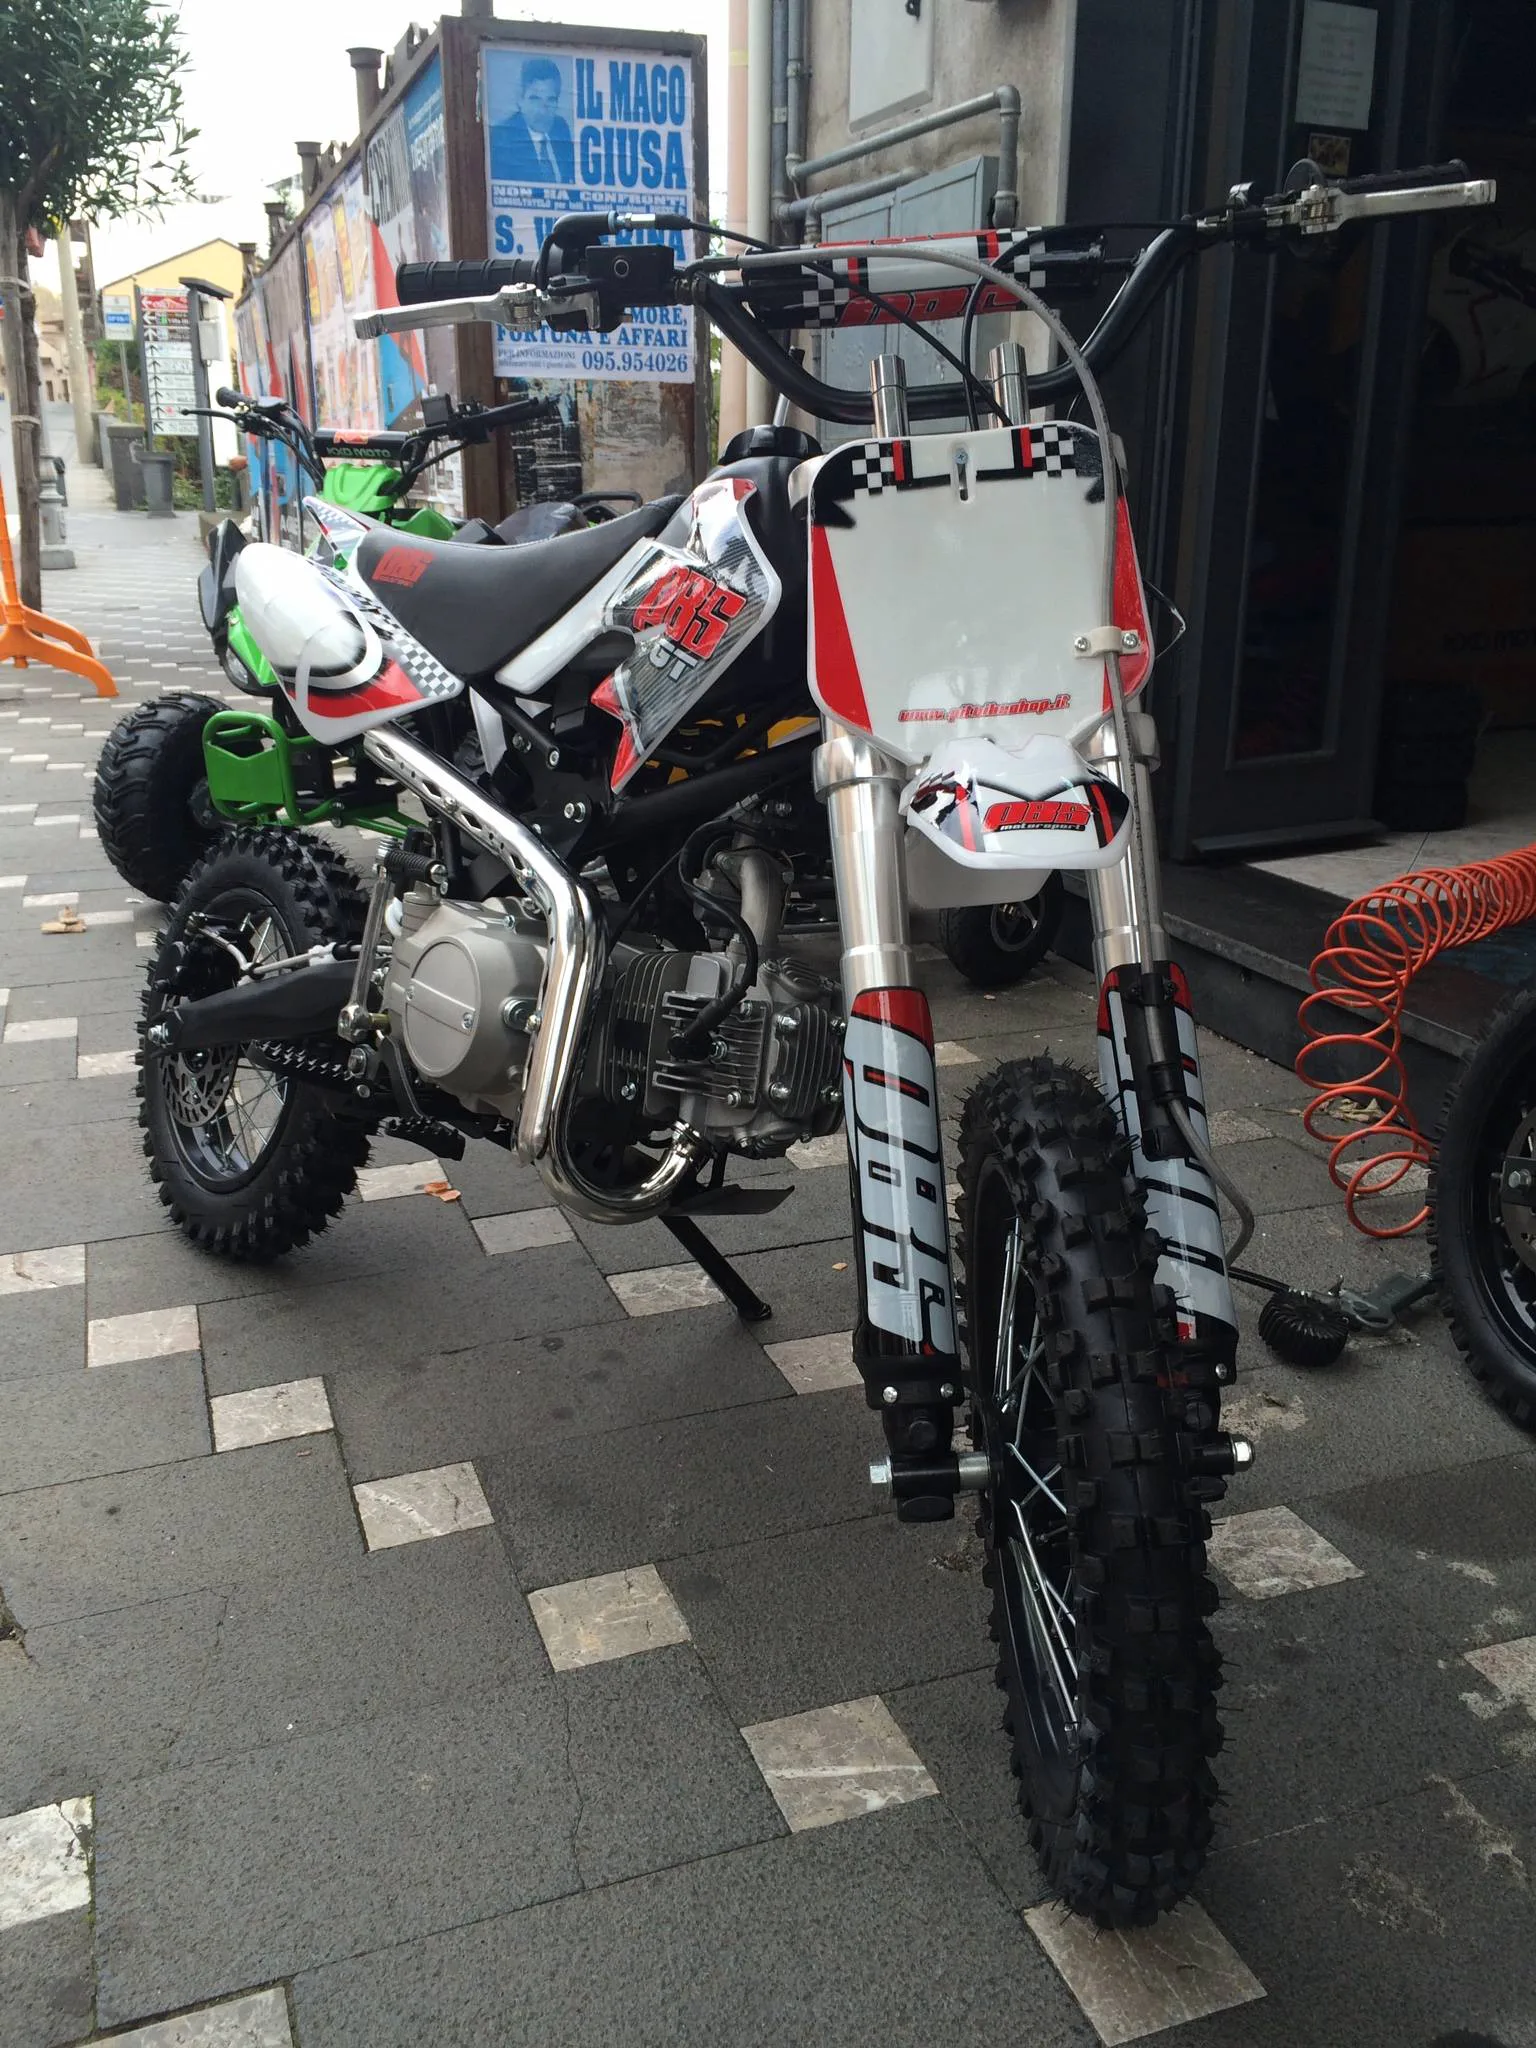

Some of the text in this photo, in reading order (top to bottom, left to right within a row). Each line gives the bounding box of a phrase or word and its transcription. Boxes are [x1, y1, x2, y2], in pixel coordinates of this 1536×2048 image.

[576, 58, 686, 126] IL MAGO
[580, 125, 687, 190] GIUSA
[493, 186, 533, 199] NON
[544, 188, 570, 201] HA
[494, 214, 524, 255] S.
[631, 306, 688, 327] MORE,
[617, 327, 688, 347] AFFARI
[582, 350, 688, 373] 095.954026
[353, 447, 392, 458] MOTO
[649, 638, 698, 681] GT
[1000, 823, 1083, 832] motorsport
